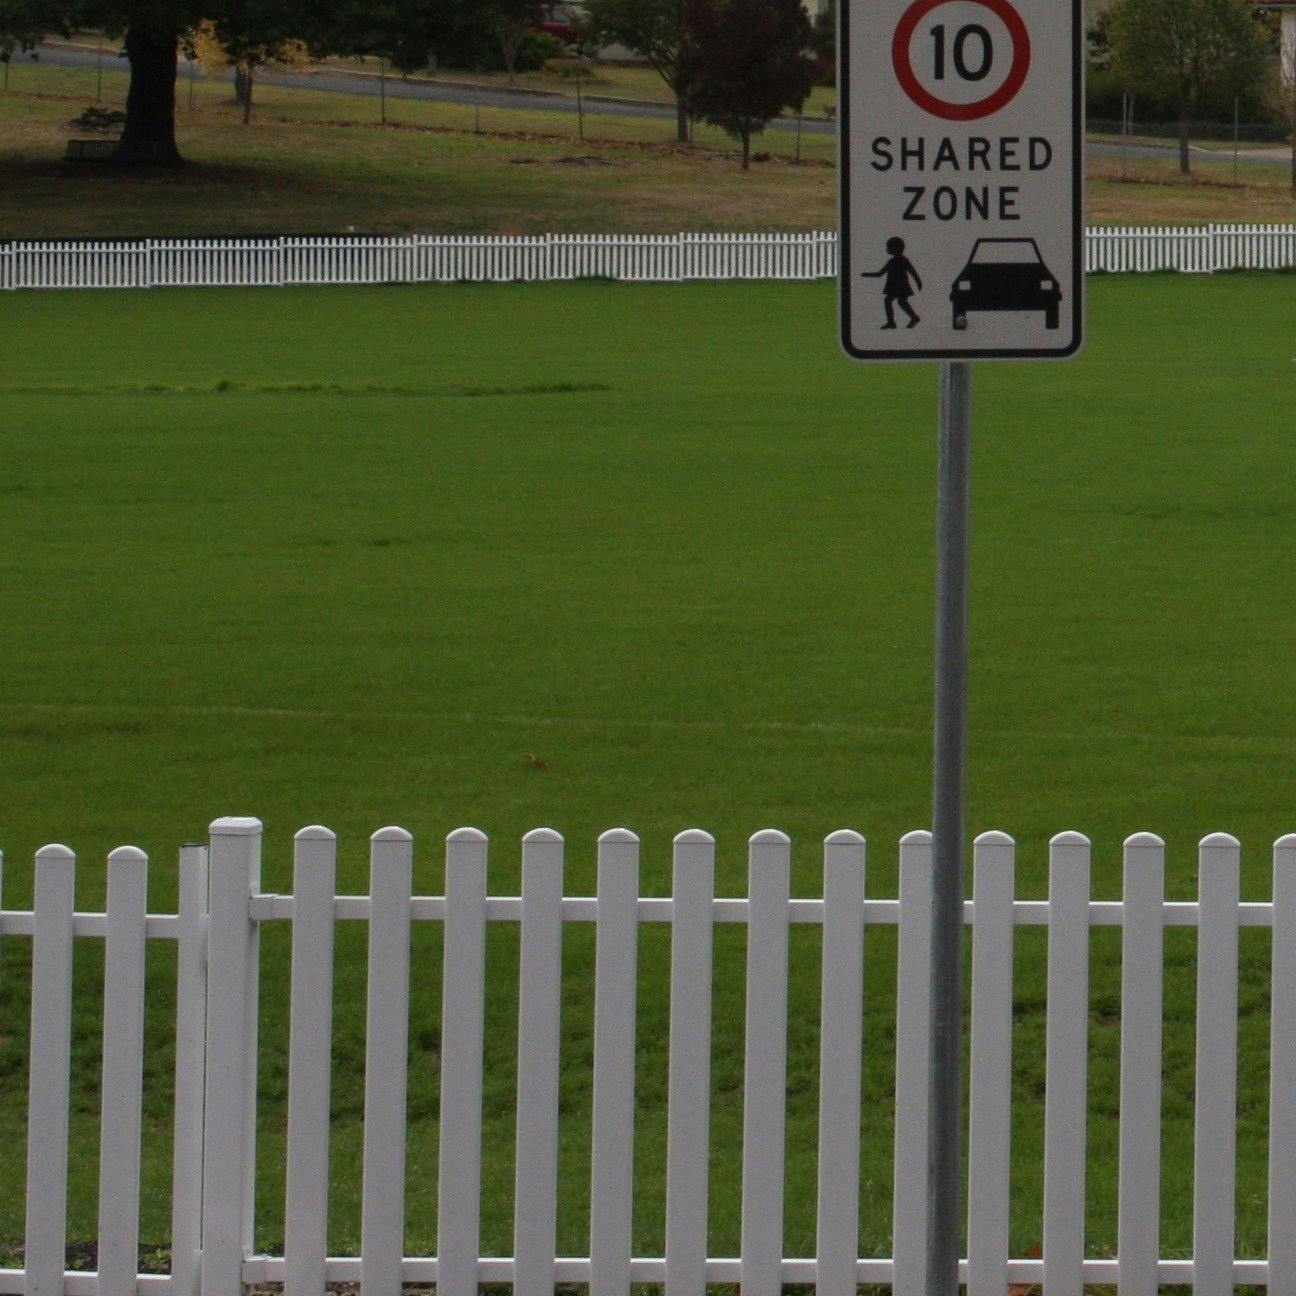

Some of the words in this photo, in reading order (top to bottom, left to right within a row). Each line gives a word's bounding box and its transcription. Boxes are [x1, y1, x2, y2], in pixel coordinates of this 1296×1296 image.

[930, 24, 993, 82] 10
[870, 136, 1053, 172] SHARED
[902, 186, 1021, 221] ZONE
